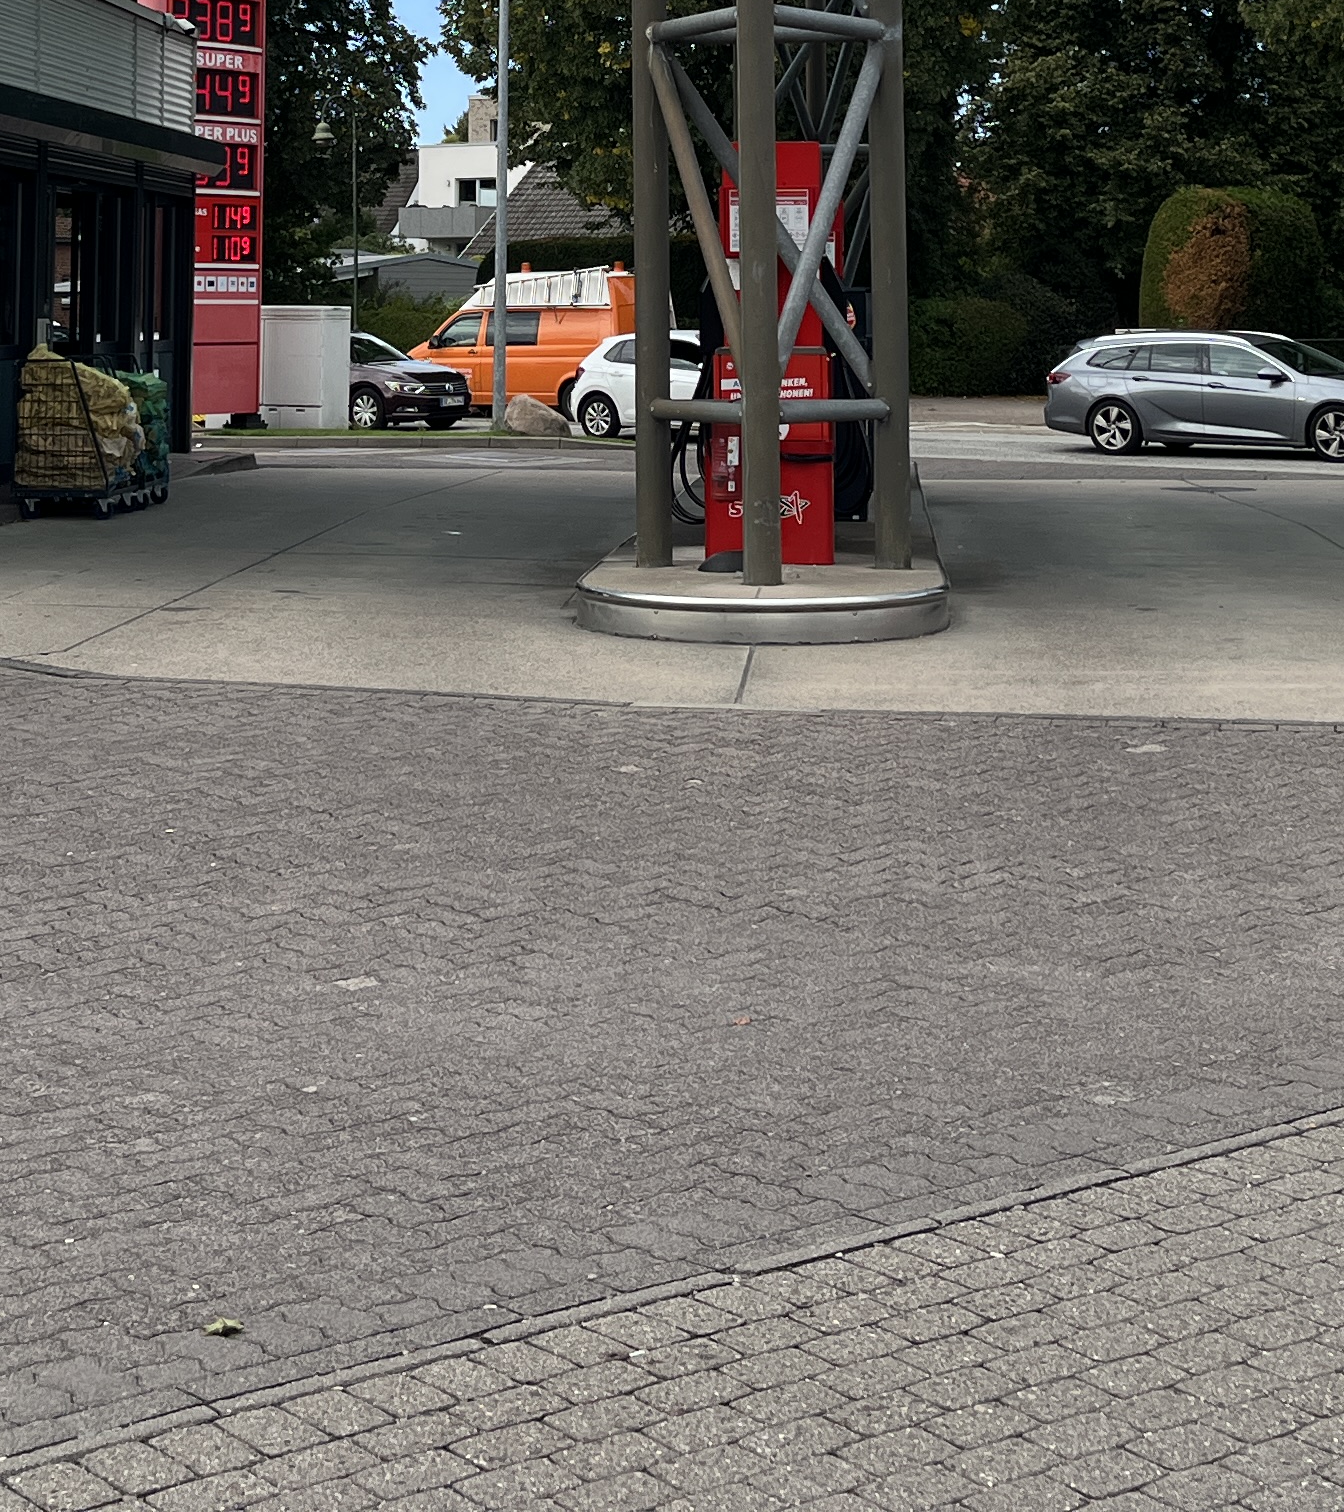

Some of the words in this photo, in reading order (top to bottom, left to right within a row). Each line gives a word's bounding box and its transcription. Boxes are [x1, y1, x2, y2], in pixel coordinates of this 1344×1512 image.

[196, 52, 243, 70] SUPER
[195, 125, 223, 141] PER
[226, 127, 257, 144] PLUS
